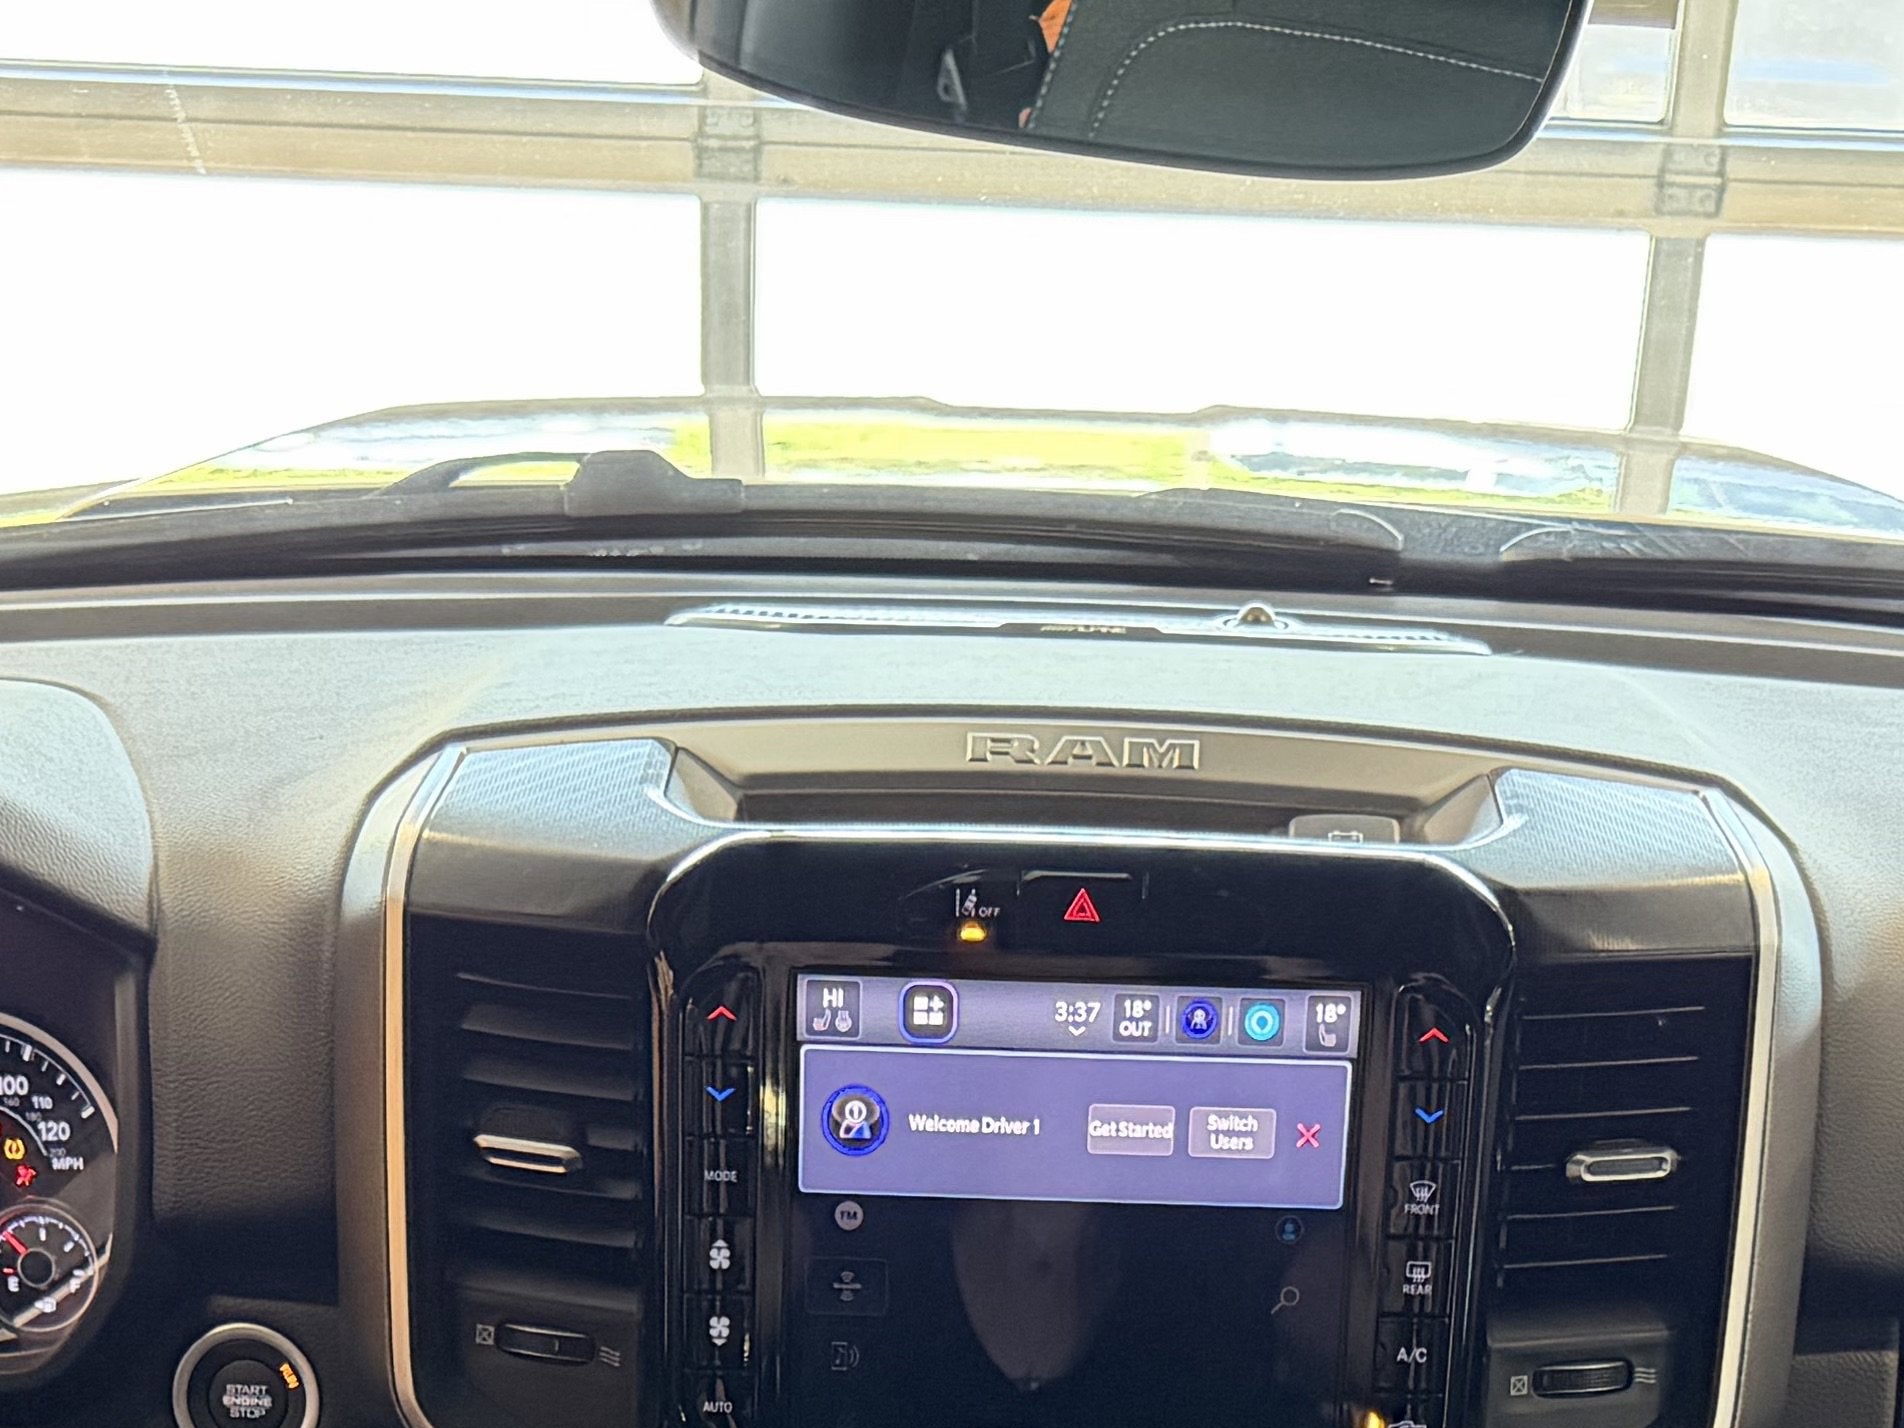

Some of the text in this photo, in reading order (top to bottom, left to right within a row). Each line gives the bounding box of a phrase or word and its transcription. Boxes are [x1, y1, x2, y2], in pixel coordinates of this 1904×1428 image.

[966, 732, 1200, 769] RAM
[979, 907, 1000, 917] OFF
[822, 987, 844, 1008] HI
[1054, 1001, 1101, 1024] 3:37
[1124, 999, 1152, 1020] 18°
[1315, 1003, 1346, 1023] 18°
[1118, 1020, 1152, 1037] OUT
[32, 1095, 53, 1110] 110
[37, 1121, 71, 1141] 120
[908, 1113, 1041, 1136] Welcome Driver 1
[1090, 1121, 1174, 1140] Get Started
[1207, 1115, 1258, 1133] Switch
[1209, 1134, 1254, 1151] Users
[52, 1157, 84, 1170] MPH
[704, 1170, 738, 1183] MODE
[1404, 1204, 1440, 1216] FRONT
[7, 1276, 20, 1292] E
[69, 1279, 82, 1293] F
[1403, 1284, 1433, 1296] REAR
[1397, 1348, 1428, 1363] A/C
[226, 1384, 267, 1396] START
[230, 1406, 266, 1419] STOP
[703, 1401, 733, 1414] AUTO
